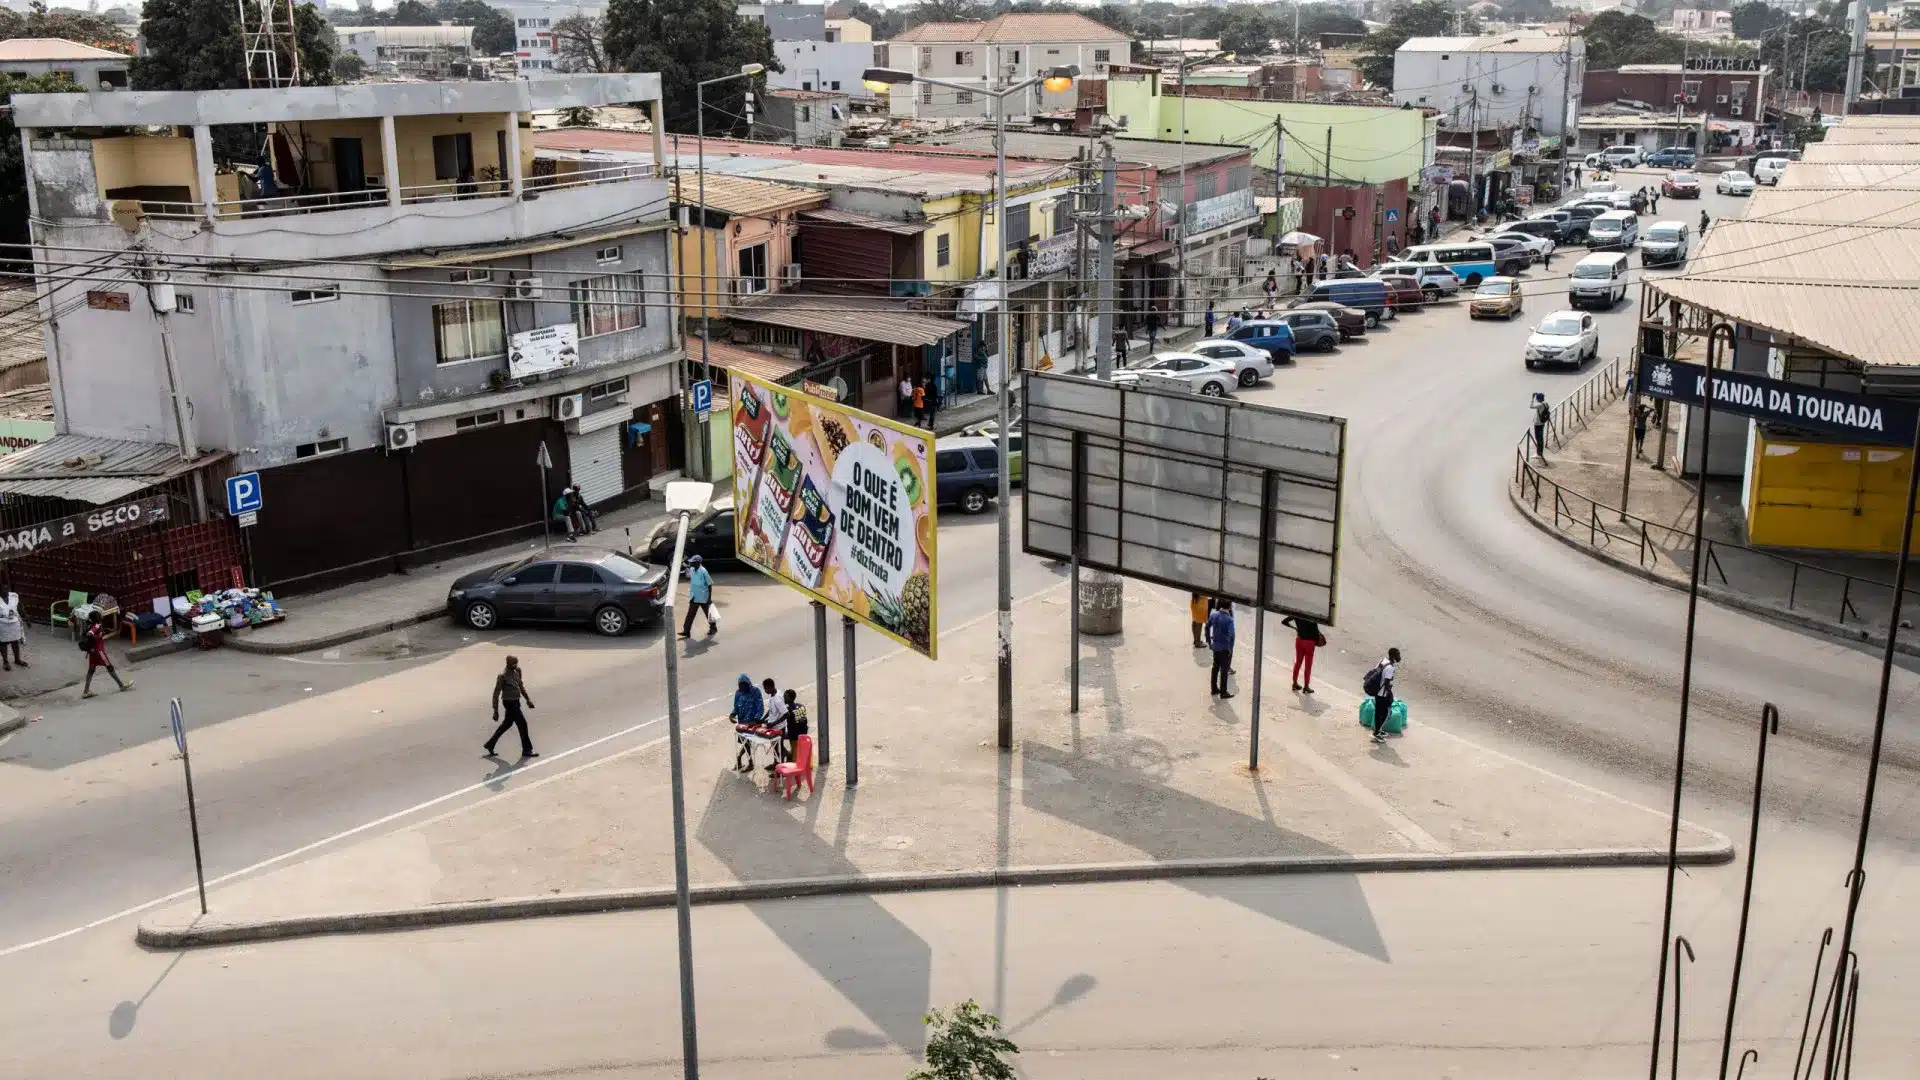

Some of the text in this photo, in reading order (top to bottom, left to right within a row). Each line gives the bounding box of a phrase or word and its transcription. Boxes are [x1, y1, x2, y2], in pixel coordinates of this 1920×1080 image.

[697, 385, 708, 409] P
[1696, 375, 1884, 432] KTANDA DA TOURADA
[235, 479, 253, 510] P
[853, 461, 898, 512] O QUE É
[62, 522, 75, 536] a
[87, 504, 140, 532] SECO
[846, 484, 871, 522] BOM
[873, 504, 900, 541] VEM
[840, 508, 854, 540] DE
[856, 521, 903, 572] DENTRO
